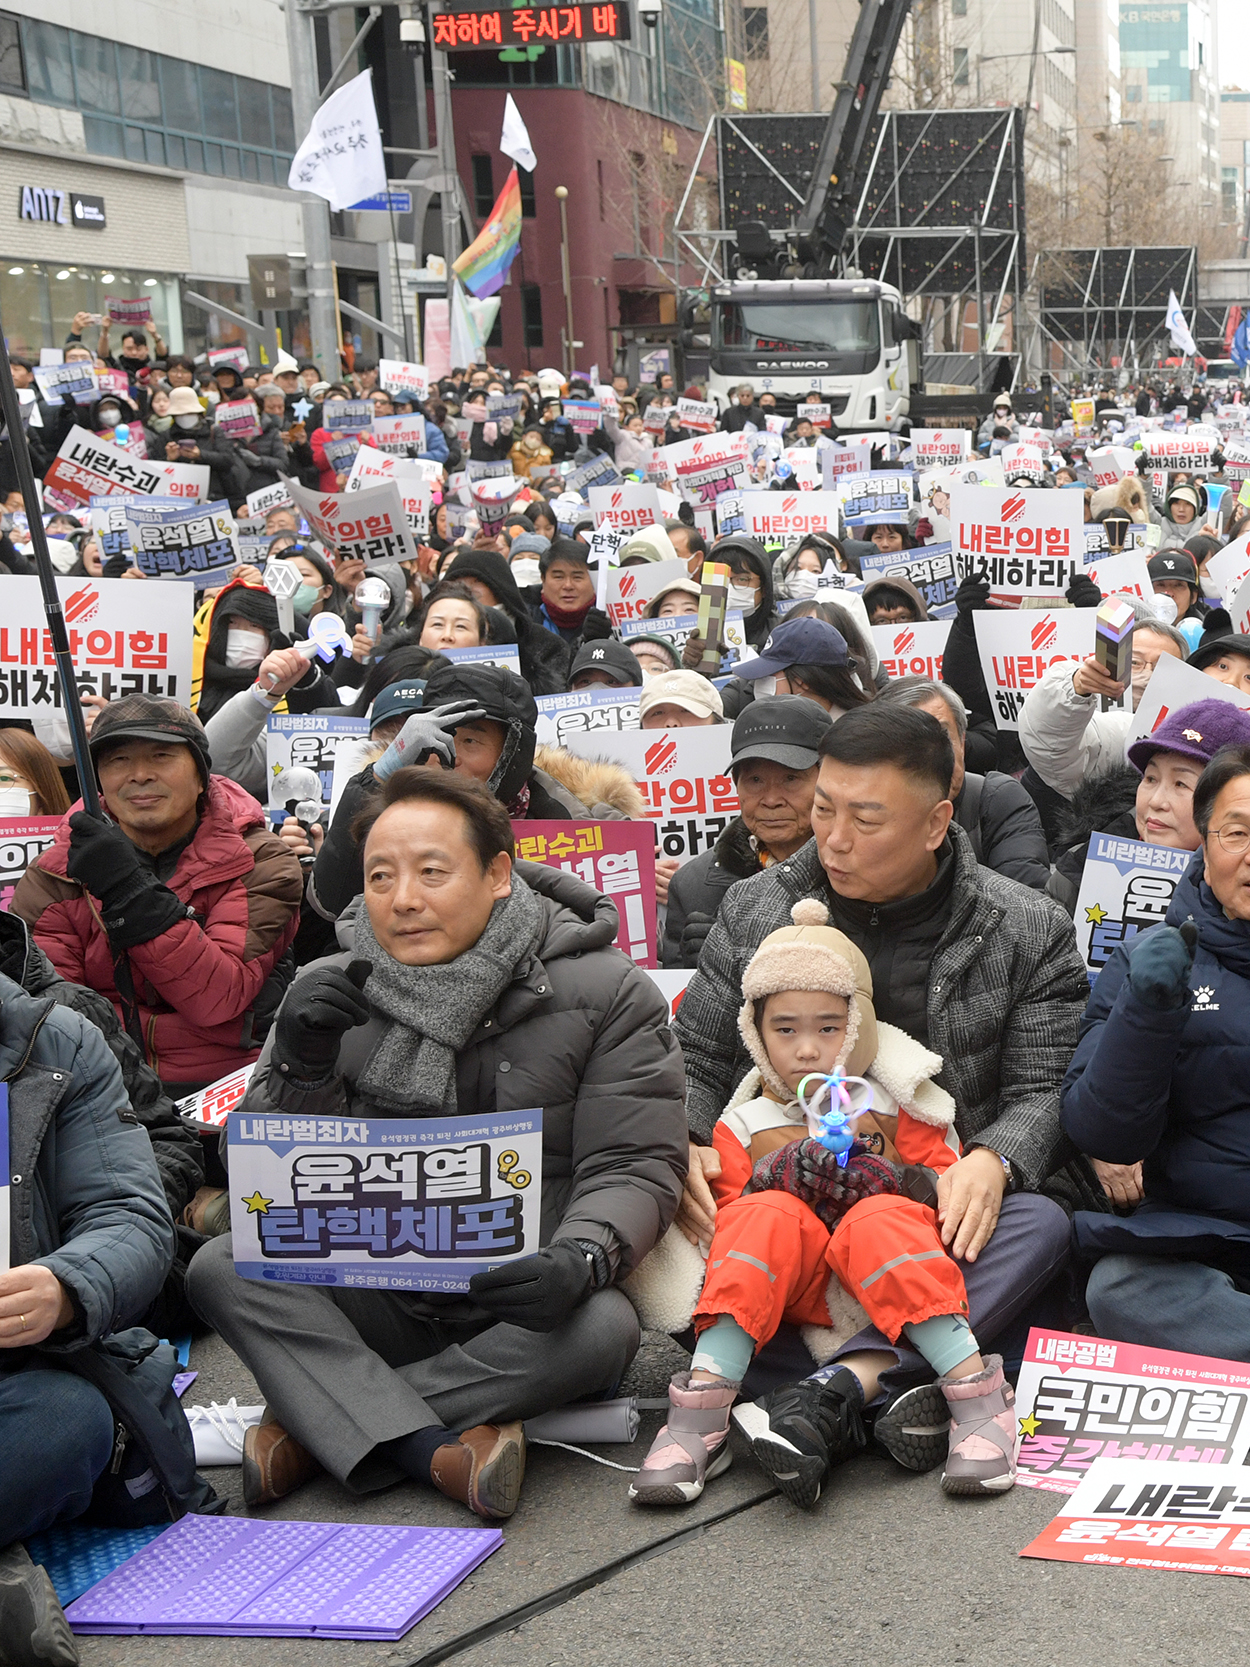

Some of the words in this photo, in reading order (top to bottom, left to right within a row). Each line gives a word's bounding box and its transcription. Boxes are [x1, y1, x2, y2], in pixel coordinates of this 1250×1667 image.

[433, 12, 502, 46] 차하여
[512, 9, 583, 42] 주시기
[592, 4, 617, 36] 바
[756, 361, 829, 370] DAEWOO
[761, 378, 774, 390] 우
[811, 378, 822, 390] 리
[917, 443, 961, 456] 내란의힘
[1149, 440, 1210, 456] 내란의힘
[68, 443, 161, 495] 내란수괴
[1003, 458, 1043, 473] 내란의힘
[851, 477, 901, 500] 윤석열
[844, 492, 909, 517] 탄핵체포
[595, 507, 655, 529] 내란의힘
[752, 515, 828, 534] 내란의힘
[141, 517, 217, 550] 윤석열
[590, 533, 622, 556] 탄핵
[959, 523, 1070, 556] 내란의힘
[137, 538, 236, 575] 탄핵체포
[864, 552, 911, 569] 내란범죄자
[956, 553, 1076, 588] 해체하라!
[626, 618, 677, 634] 내란범죄자
[0, 627, 168, 670] 내란의힘
[271, 717, 329, 732] 내란범죄자
[744, 725, 788, 735] DESCRIBE
[638, 774, 741, 818] 란의힘
[1097, 839, 1190, 872] 내란범죄자
[239, 1119, 370, 1144] 내란범죄자
[380, 1133, 417, 1143] 윤석열정권
[420, 1133, 435, 1142] 즉각
[436, 1131, 452, 1141] 퇴진
[453, 1126, 490, 1139] 사회대개혁
[492, 1120, 533, 1135] 광주비상행동
[293, 1144, 484, 1202] 윤석열
[260, 1196, 518, 1252] 탄핵체포
[308, 1273, 327, 1282] 안내
[343, 1275, 390, 1288] 광주은행
[391, 1276, 471, 1291] 064-107-0240
[1034, 1338, 1118, 1368] 내란공범
[1034, 1378, 1242, 1443] 국민의힘
[1055, 1520, 1231, 1551] 윤석열
